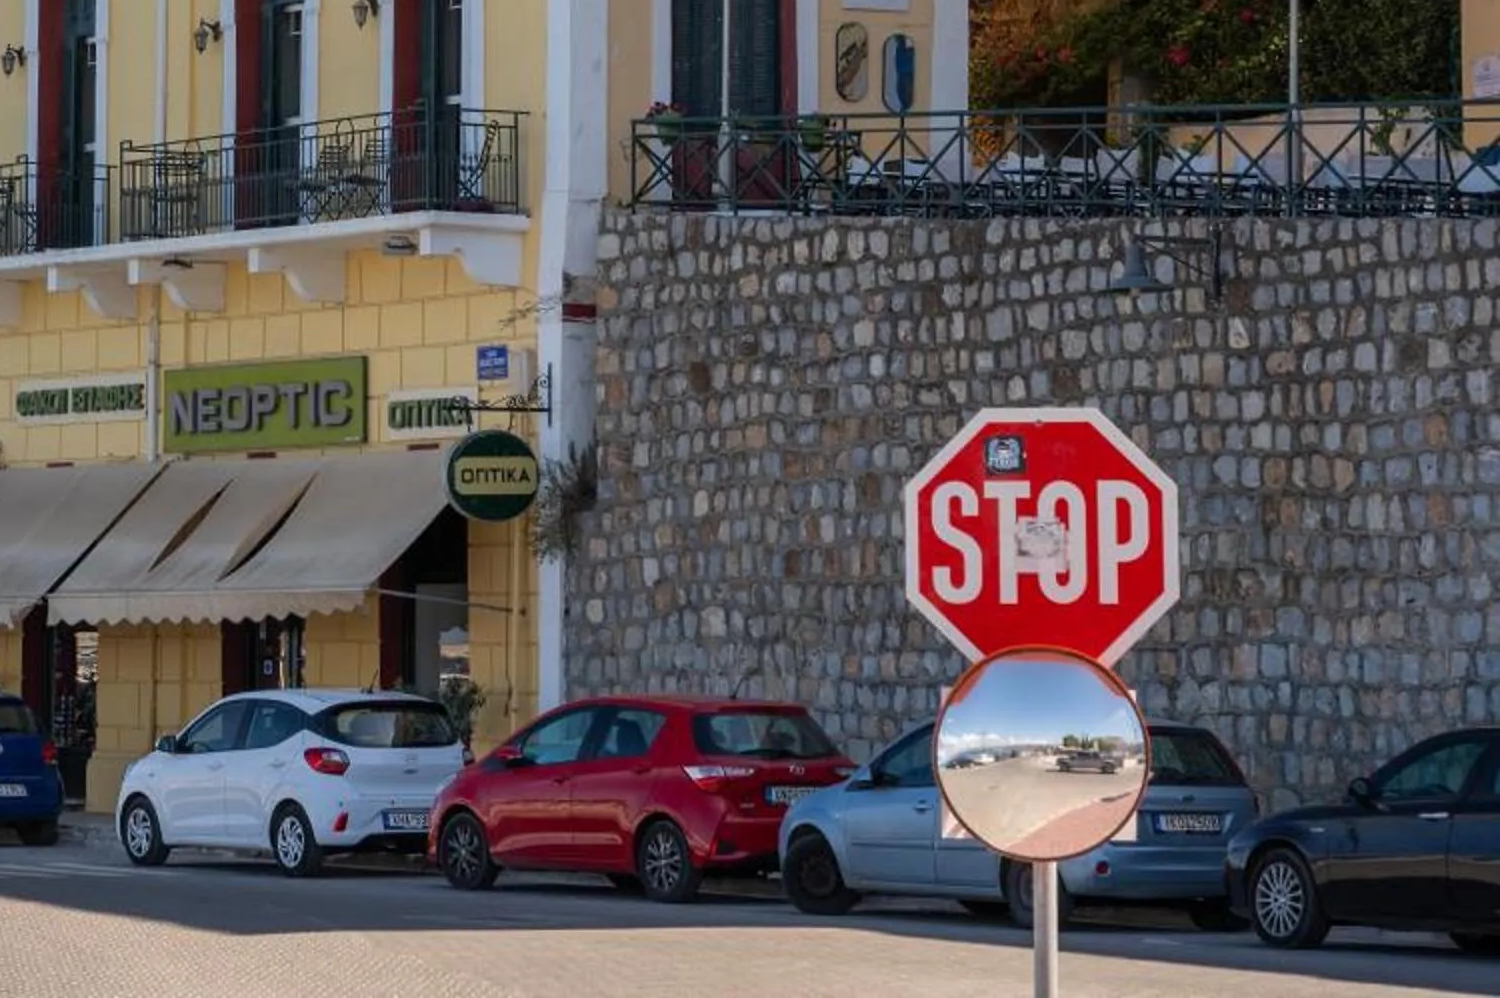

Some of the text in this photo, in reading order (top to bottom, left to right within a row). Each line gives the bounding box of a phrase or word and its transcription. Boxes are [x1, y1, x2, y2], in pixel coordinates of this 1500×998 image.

[168, 379, 354, 436] NEOPTIC
[460, 467, 531, 484] ΟΠΤΙΚΑ
[931, 479, 1150, 605] STOP
